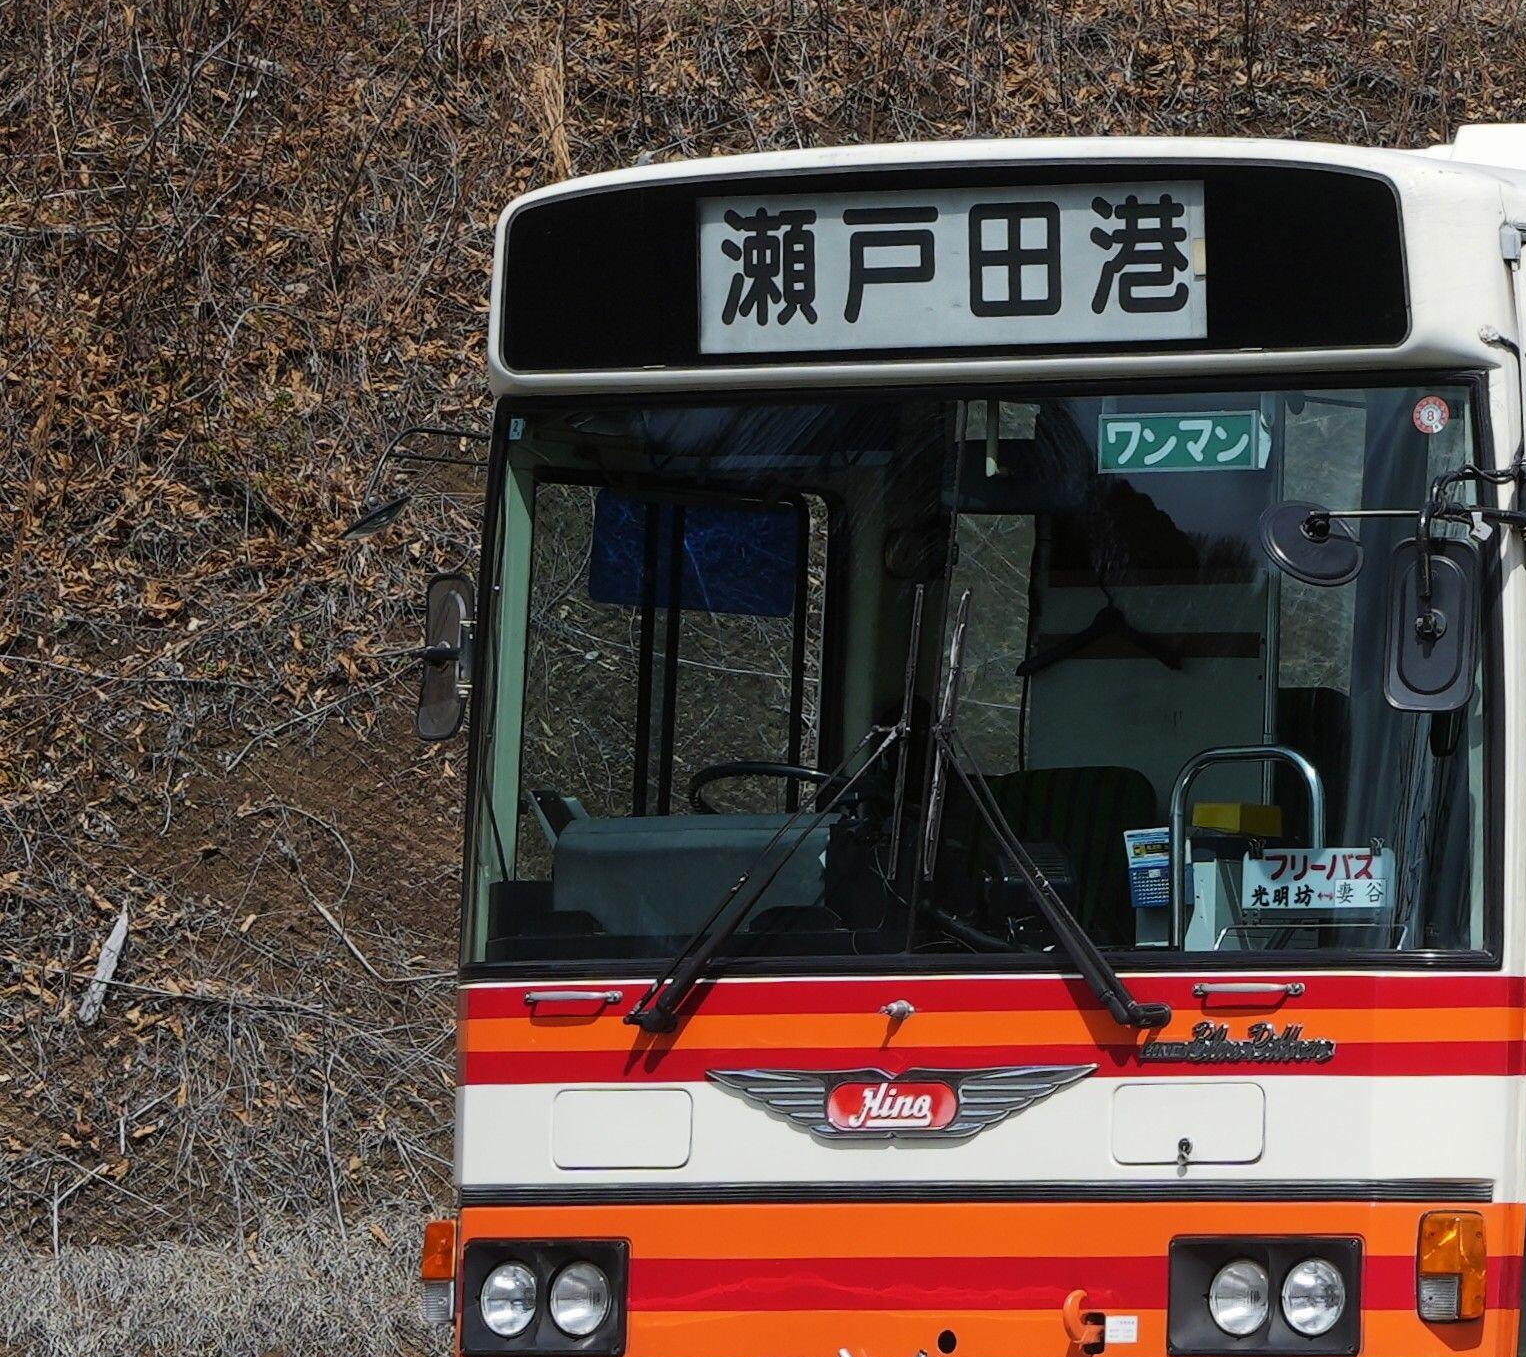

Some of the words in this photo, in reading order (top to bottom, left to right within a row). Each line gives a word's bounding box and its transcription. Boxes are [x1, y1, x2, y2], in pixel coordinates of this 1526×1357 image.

[720, 194, 1190, 326] 瀬戸田港
[1107, 419, 1249, 466] ワンマン
[1265, 854, 1375, 881] フリーバス
[1251, 884, 1314, 907] 光明坊
[848, 1082, 933, 1128] Hino
